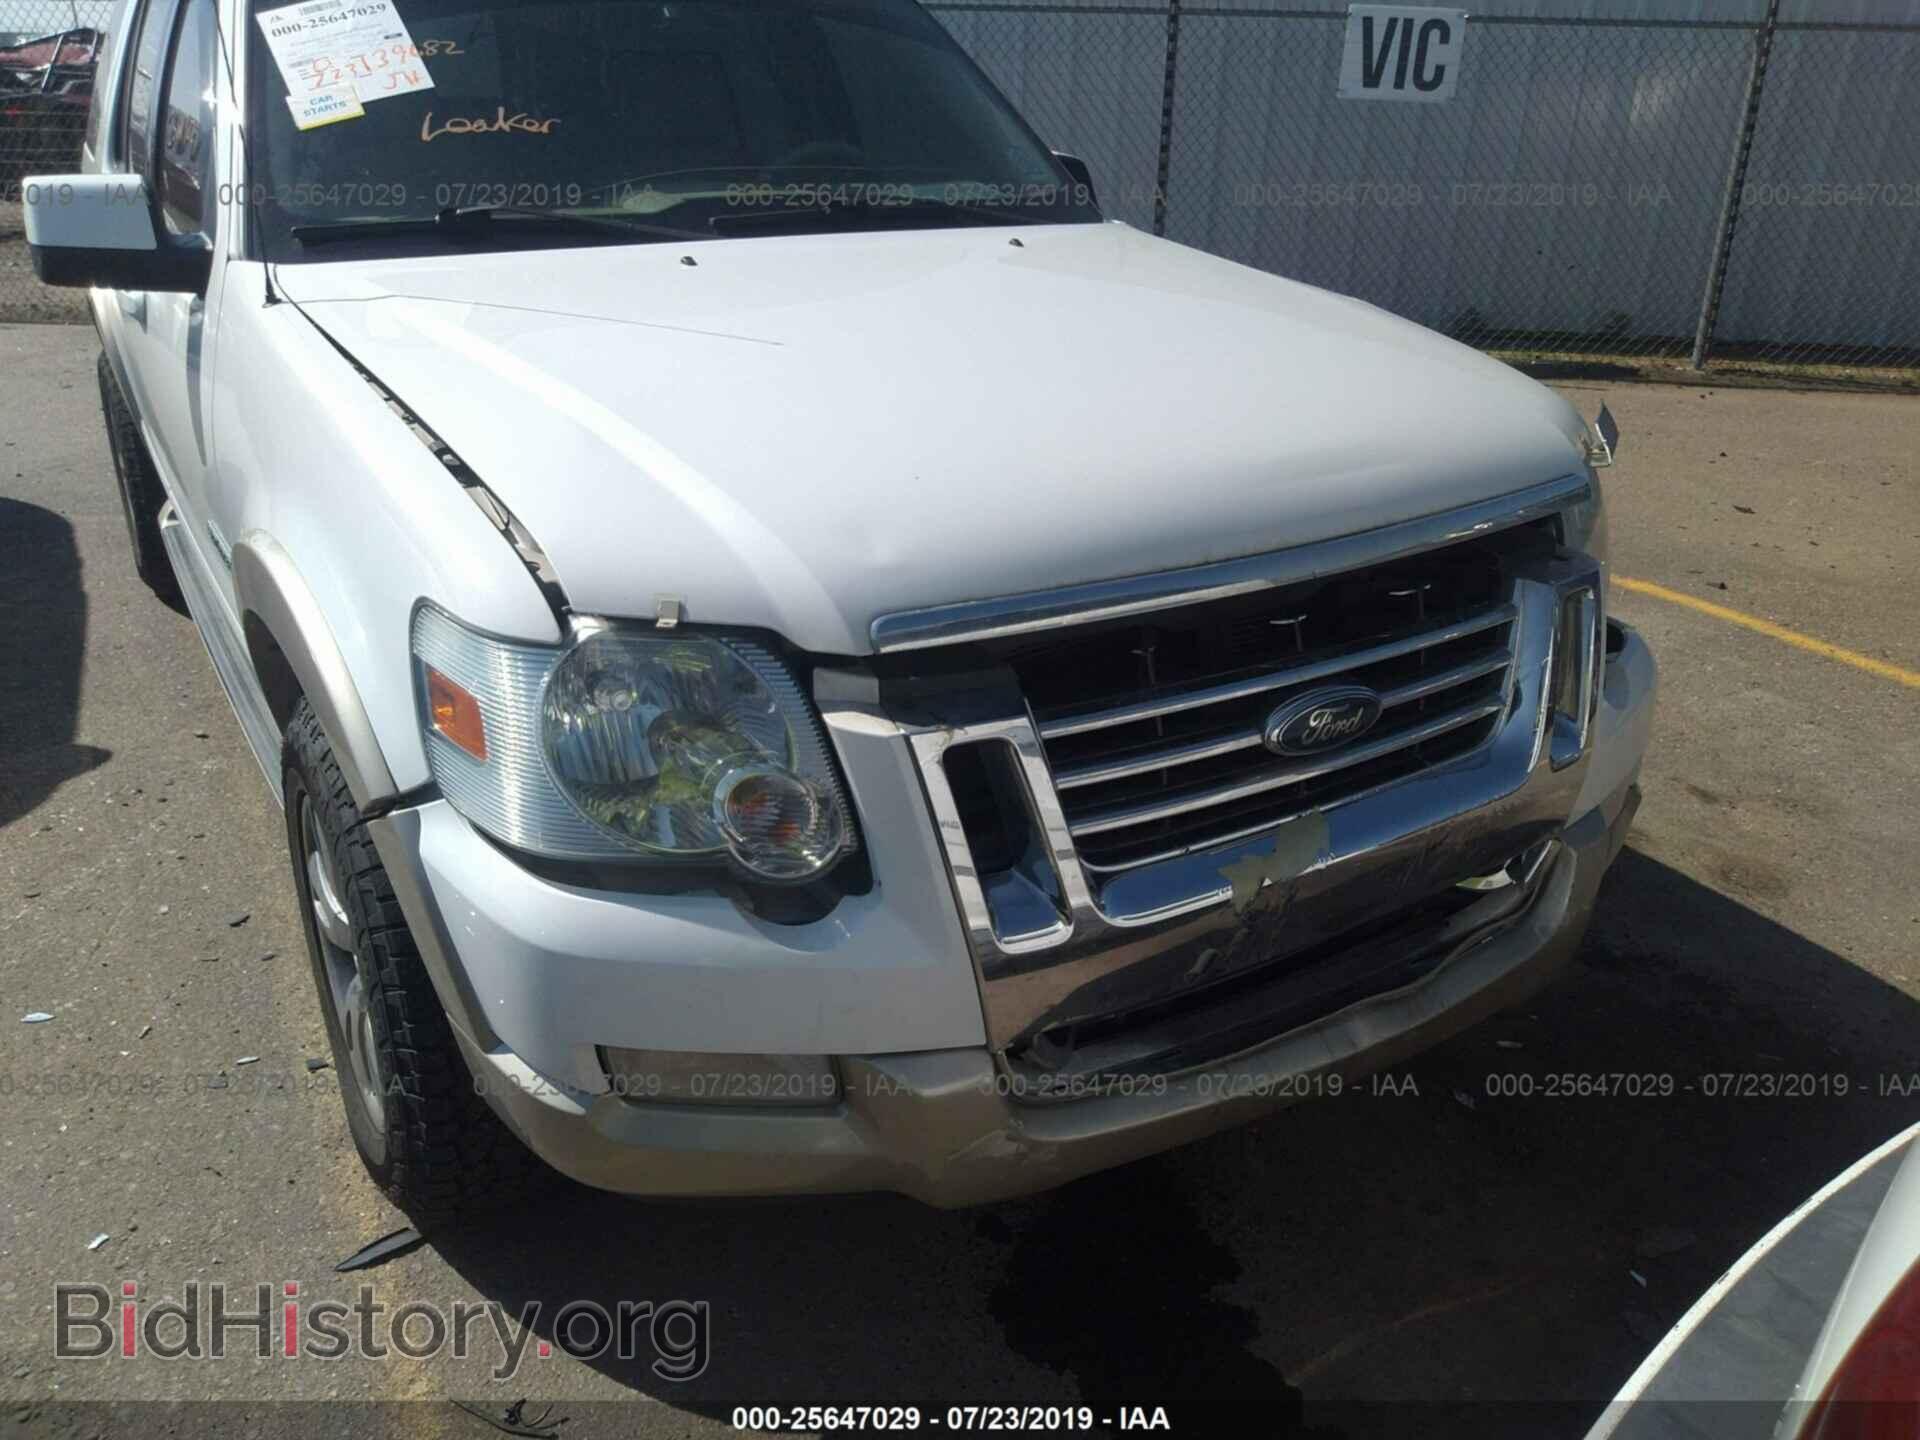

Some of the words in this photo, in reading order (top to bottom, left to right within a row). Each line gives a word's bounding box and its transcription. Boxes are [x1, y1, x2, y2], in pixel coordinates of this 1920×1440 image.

[271, 4, 387, 37] 000-25647029
[1361, 15, 1451, 92] VIC
[303, 101, 348, 116] STARTS
[310, 95, 334, 105] CAR
[1302, 704, 1364, 745] Ford
